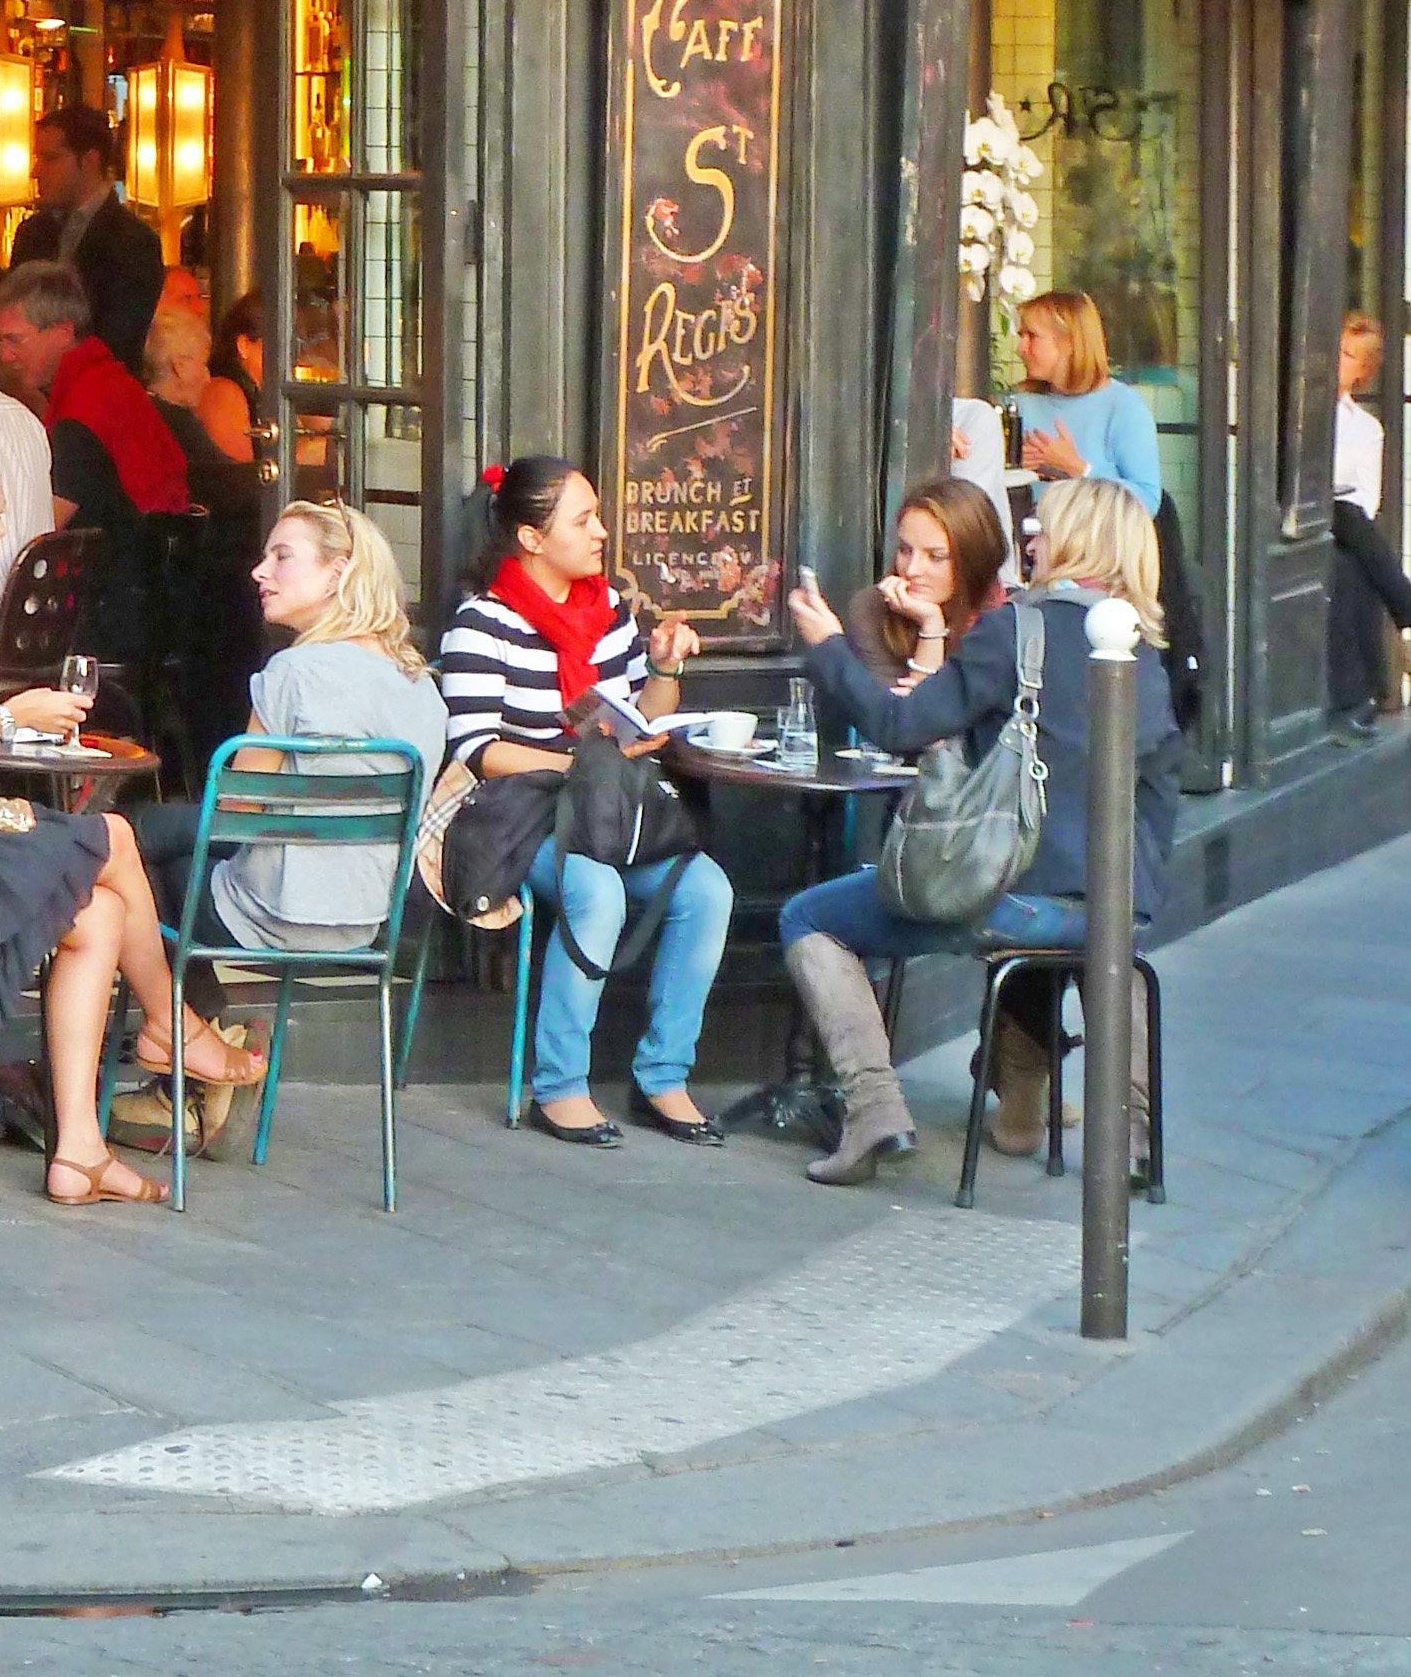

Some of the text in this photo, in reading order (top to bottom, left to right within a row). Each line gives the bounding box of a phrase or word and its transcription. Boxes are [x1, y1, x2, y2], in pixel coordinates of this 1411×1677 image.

[626, 478, 752, 504] BRUNCH ET
[626, 509, 761, 534] BREAKFAST
